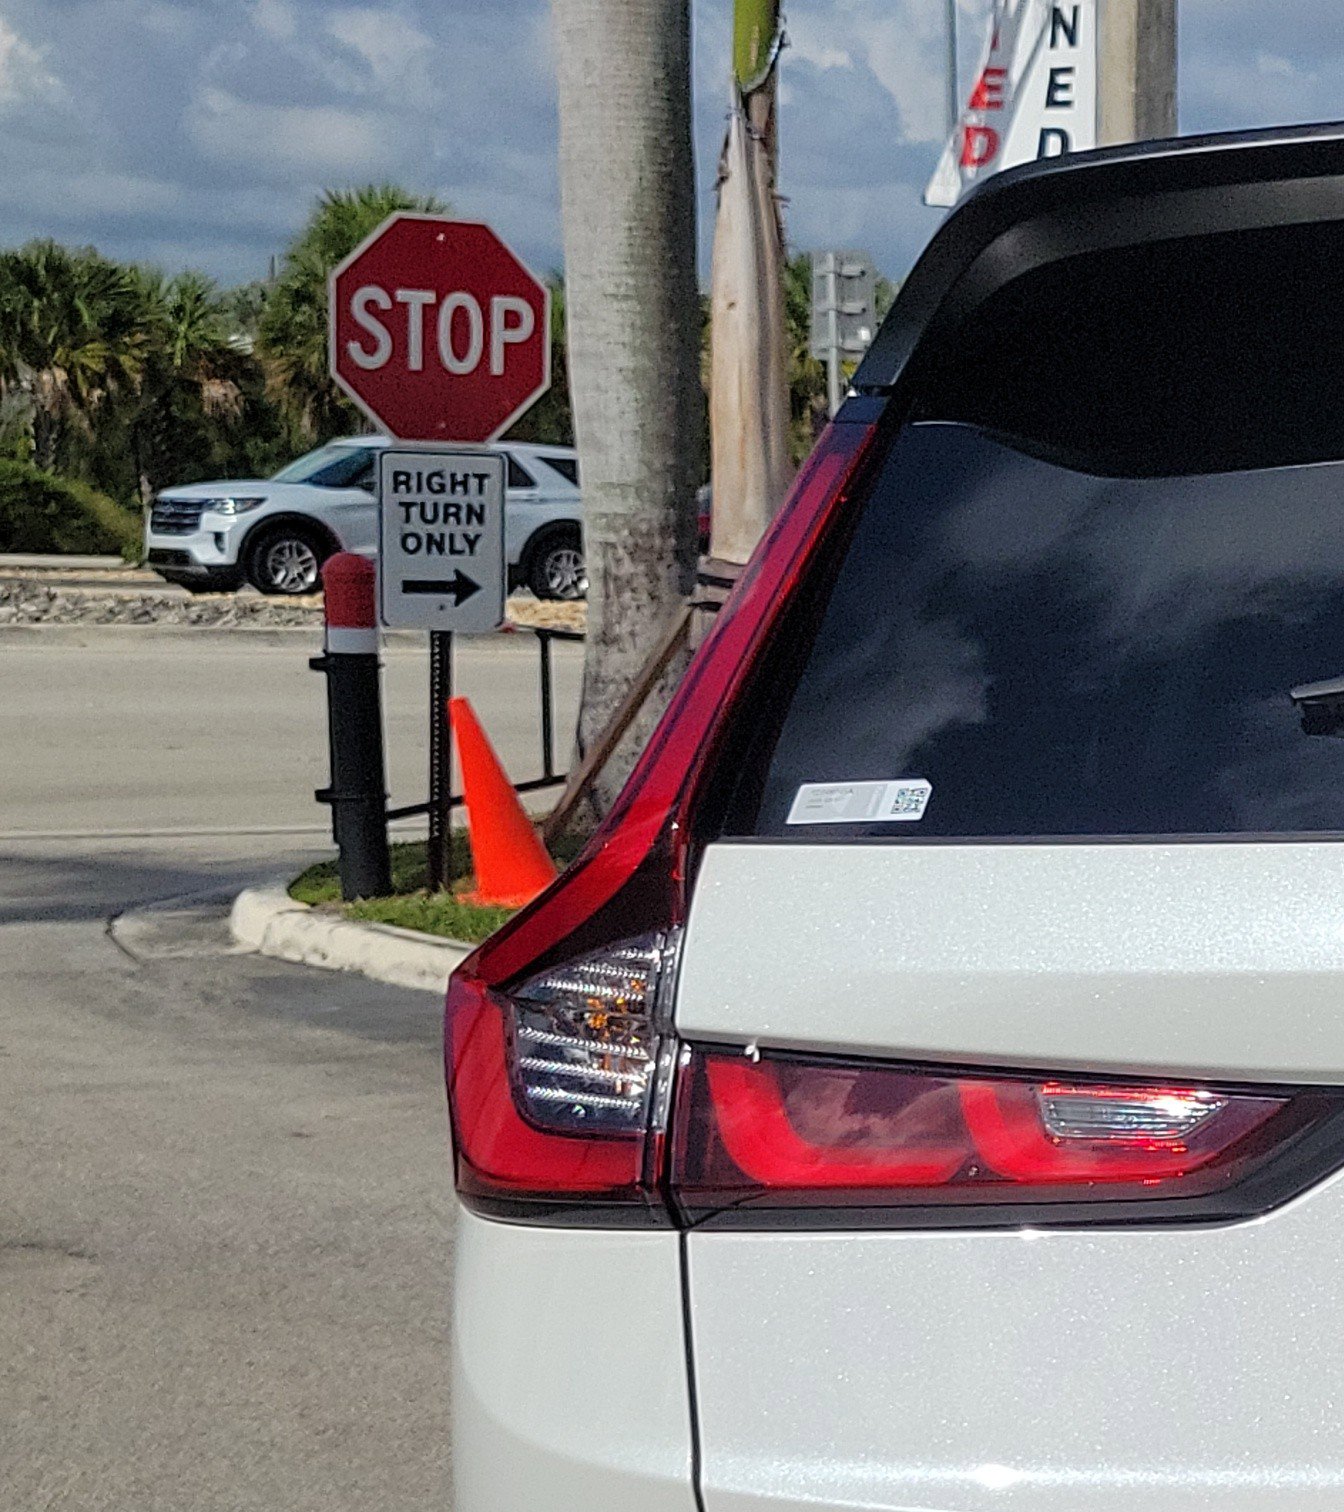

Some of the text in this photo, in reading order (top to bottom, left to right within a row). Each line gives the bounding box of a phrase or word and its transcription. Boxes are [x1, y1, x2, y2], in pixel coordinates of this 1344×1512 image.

[961, 30, 1007, 168] ED
[347, 284, 536, 376] STOP
[392, 470, 491, 496] RIGHT
[399, 501, 486, 526] TURN
[401, 532, 482, 556] ONLY
